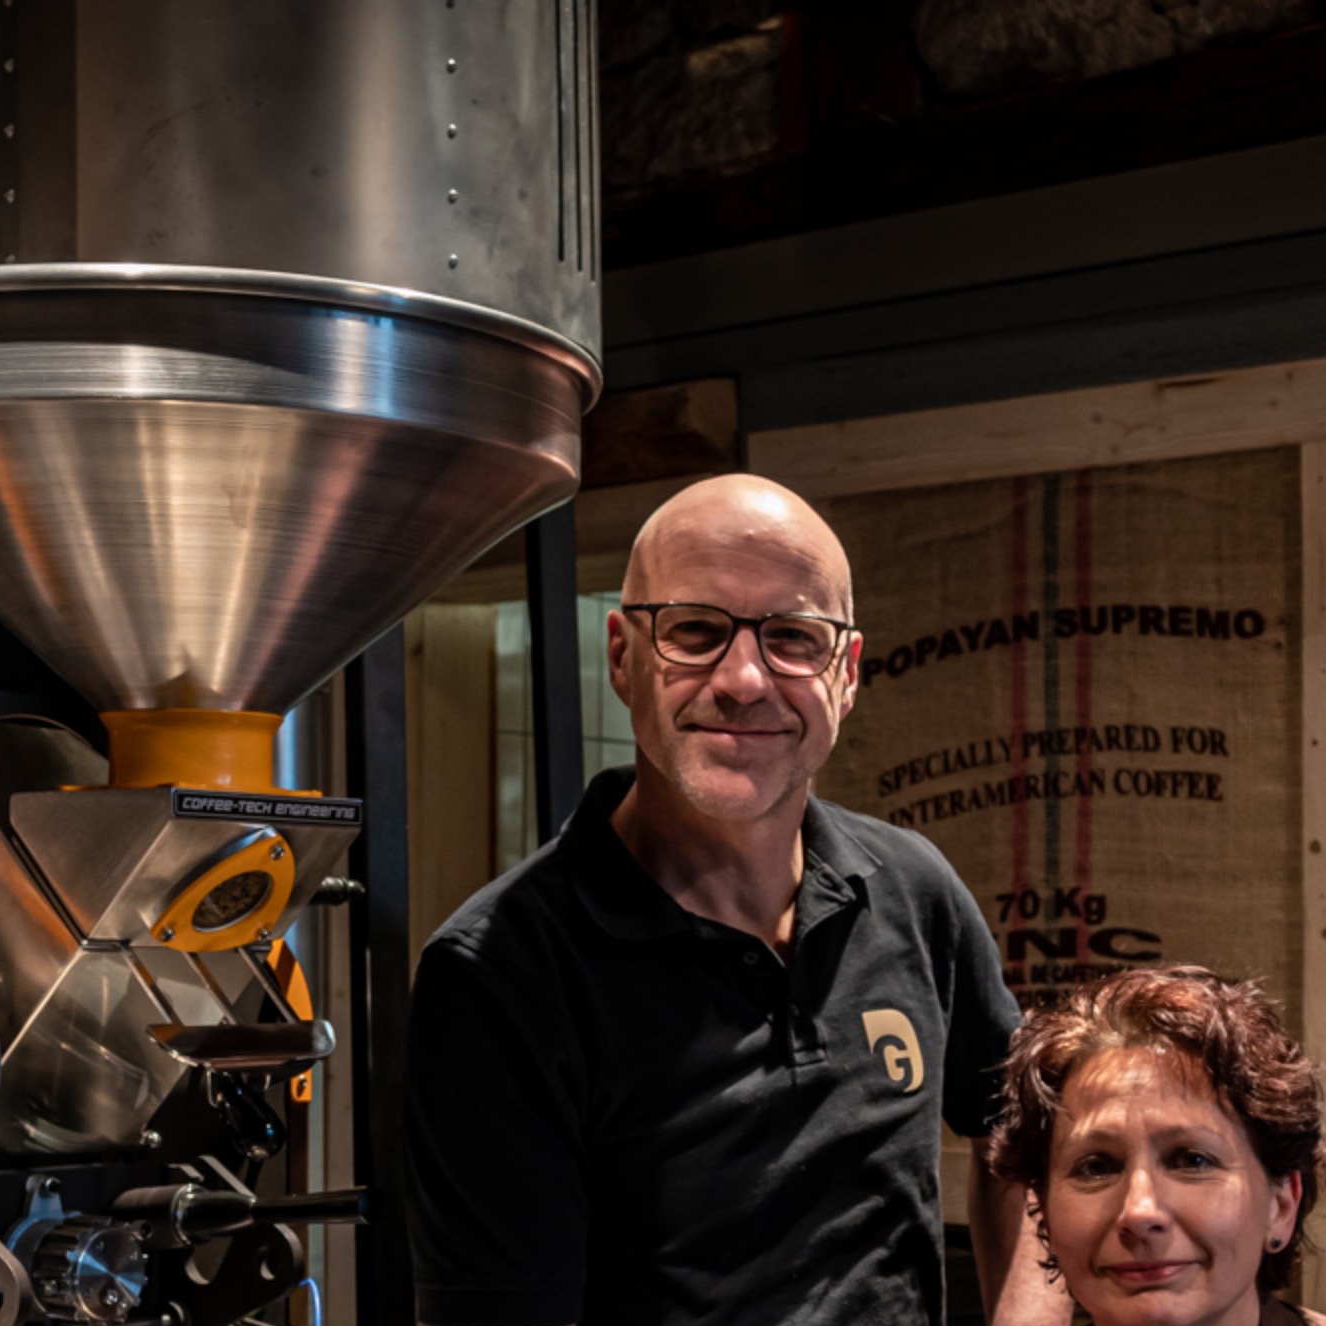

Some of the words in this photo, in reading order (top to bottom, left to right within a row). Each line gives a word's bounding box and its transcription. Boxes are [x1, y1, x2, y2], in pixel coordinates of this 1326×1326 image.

[862, 610, 1039, 687] POPAYAN
[1054, 604, 1265, 640] SUPREMO
[878, 736, 1014, 798] SPECIALLY
[1022, 725, 1160, 759] PREPARED
[1170, 726, 1229, 757] FOR
[889, 769, 1106, 827] INTERAMERICAN
[1114, 767, 1225, 802] COFFEE
[996, 890, 1040, 923] 70
[1055, 887, 1107, 925] Kg
[994, 927, 1162, 962] NC
